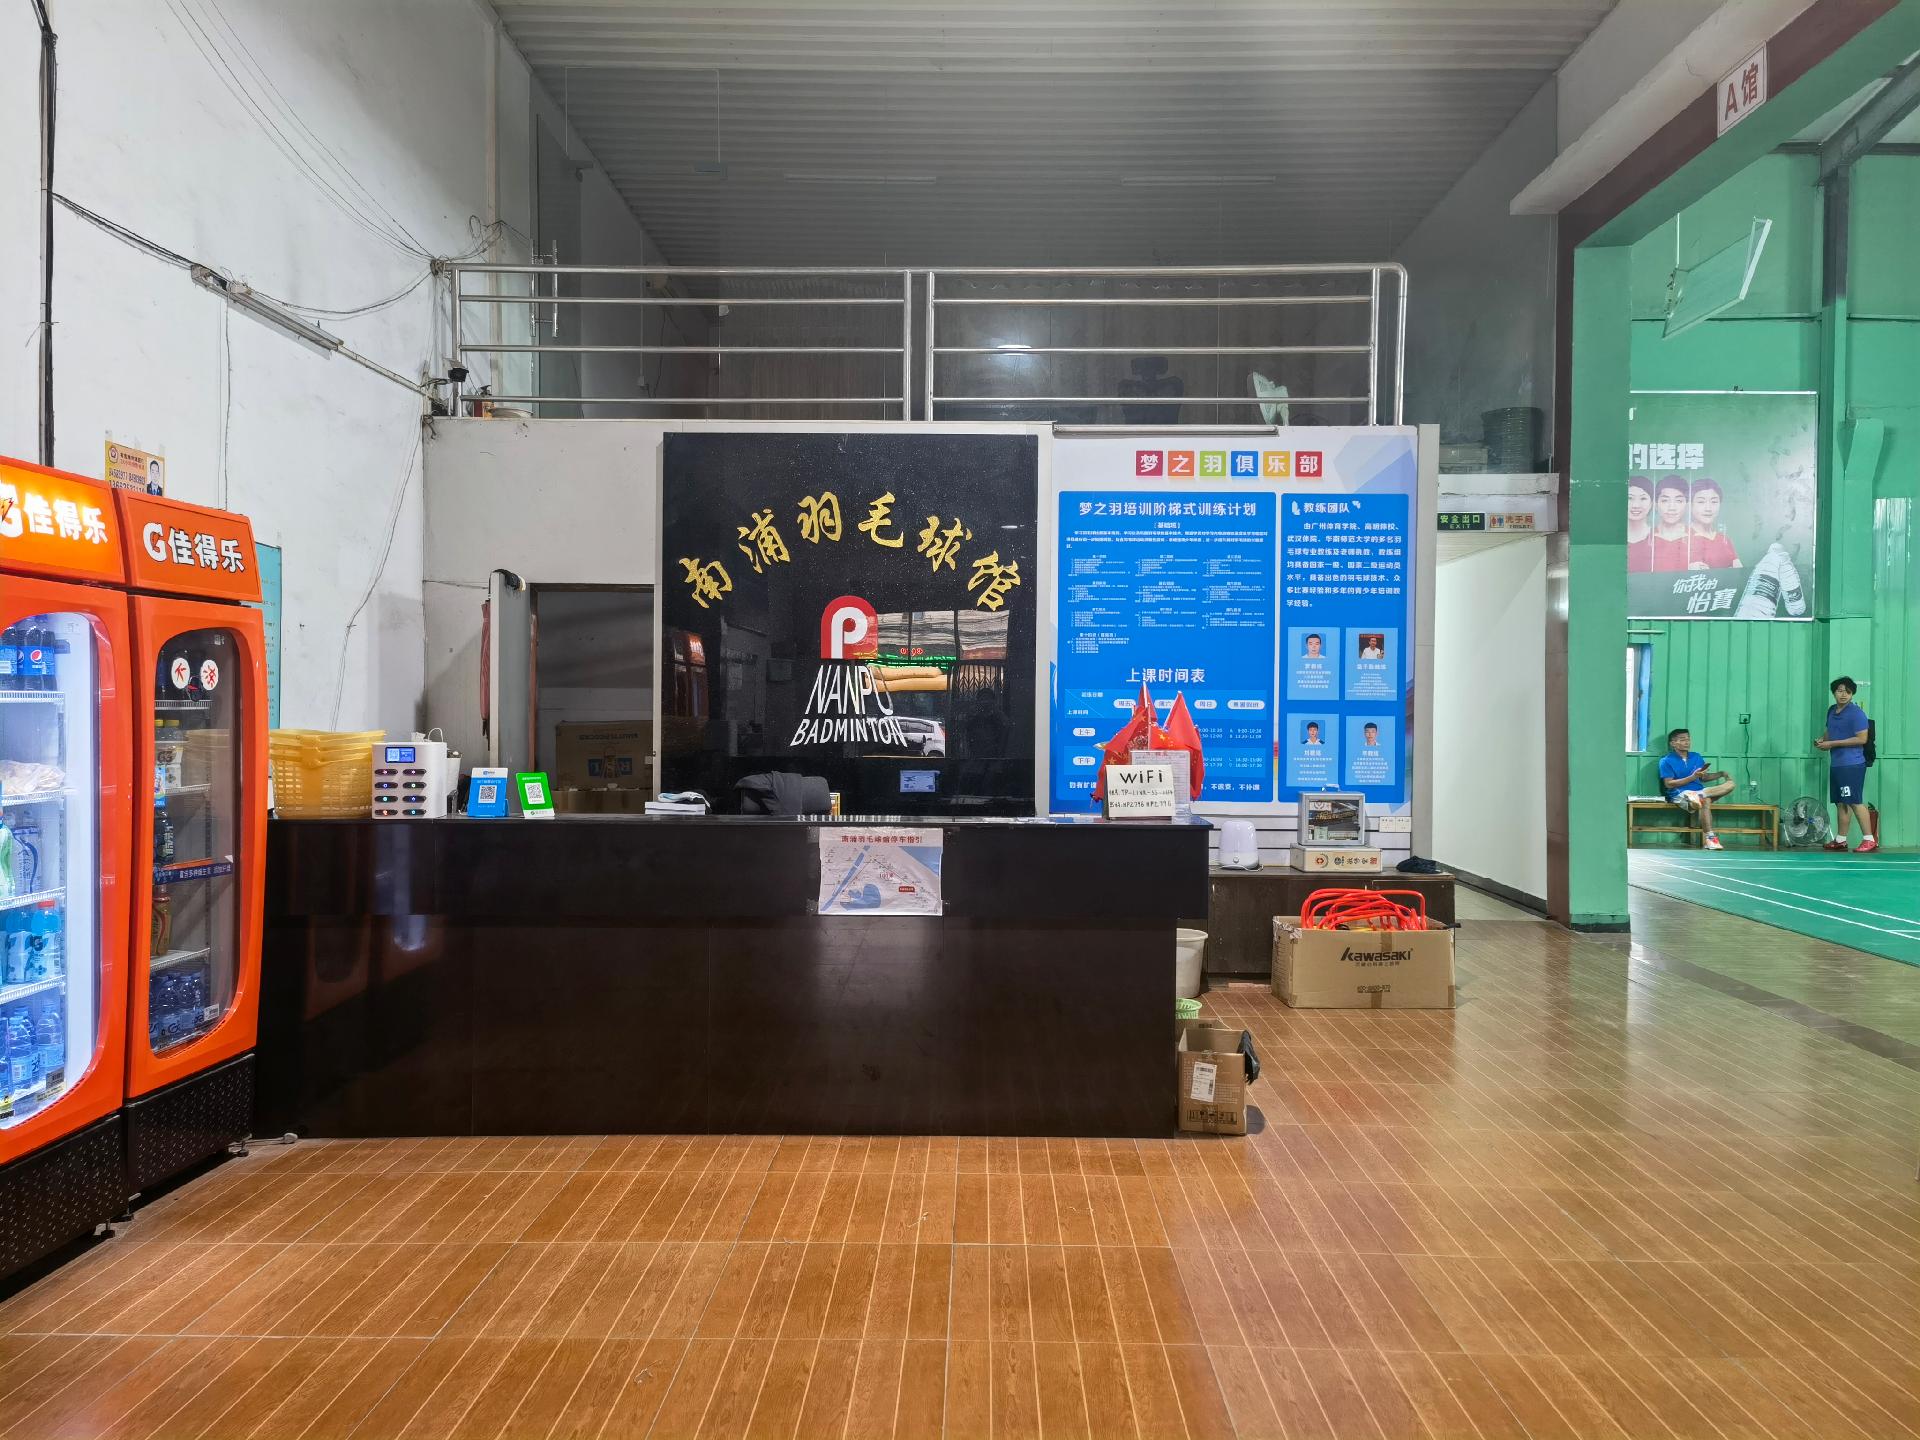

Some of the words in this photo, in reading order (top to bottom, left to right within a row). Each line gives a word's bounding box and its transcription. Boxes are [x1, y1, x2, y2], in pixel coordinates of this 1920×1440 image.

[1725, 62, 1758, 120] A馆
[1140, 454, 1317, 474] 梦之羽俱乐部
[1079, 502, 1257, 516] 梦之羽培训阶梯式训练计划
[1304, 503, 1349, 513] 教练团队
[1440, 515, 1480, 524] 安全出口
[143, 522, 246, 573] G佳得乐
[1673, 573, 1718, 594] 你我的
[1126, 668, 1206, 683] 上课时间表
[805, 665, 893, 715] NANPU
[790, 718, 908, 748] BADMINTON
[1120, 770, 1163, 784] WiFi
